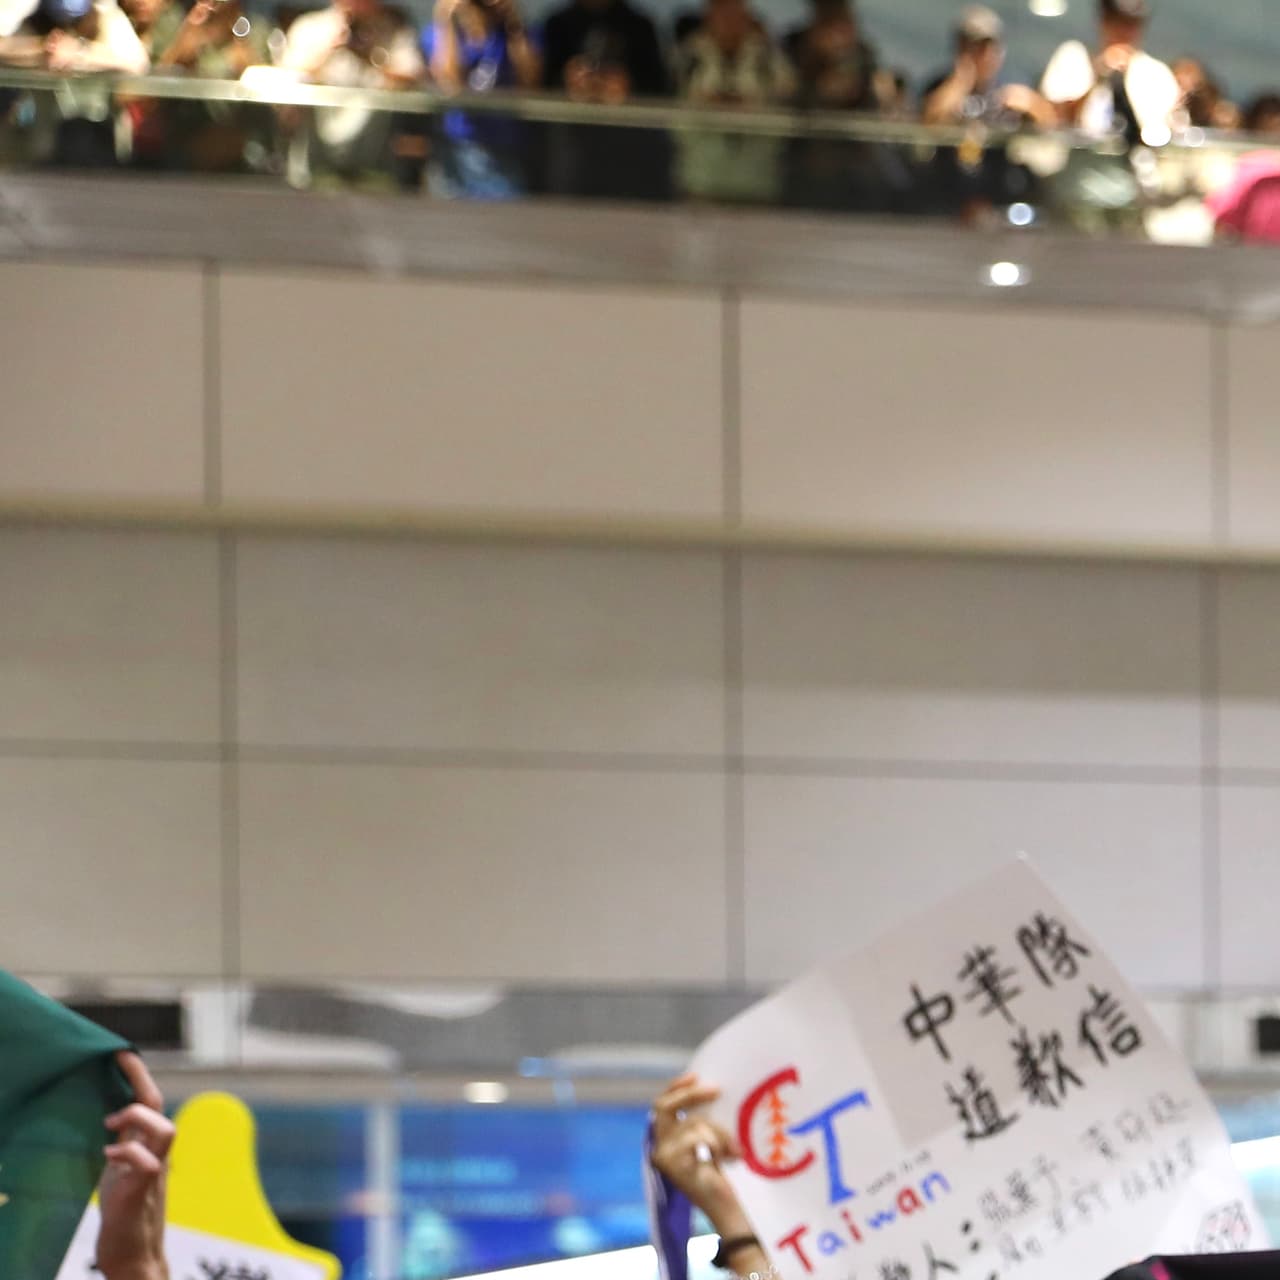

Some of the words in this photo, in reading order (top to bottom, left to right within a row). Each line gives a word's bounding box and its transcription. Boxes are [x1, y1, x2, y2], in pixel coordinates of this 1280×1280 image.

[901, 910, 1092, 1062] 中華隊
[943, 984, 1144, 1144] 道歉信
[776, 1166, 952, 1275] Taiwan
